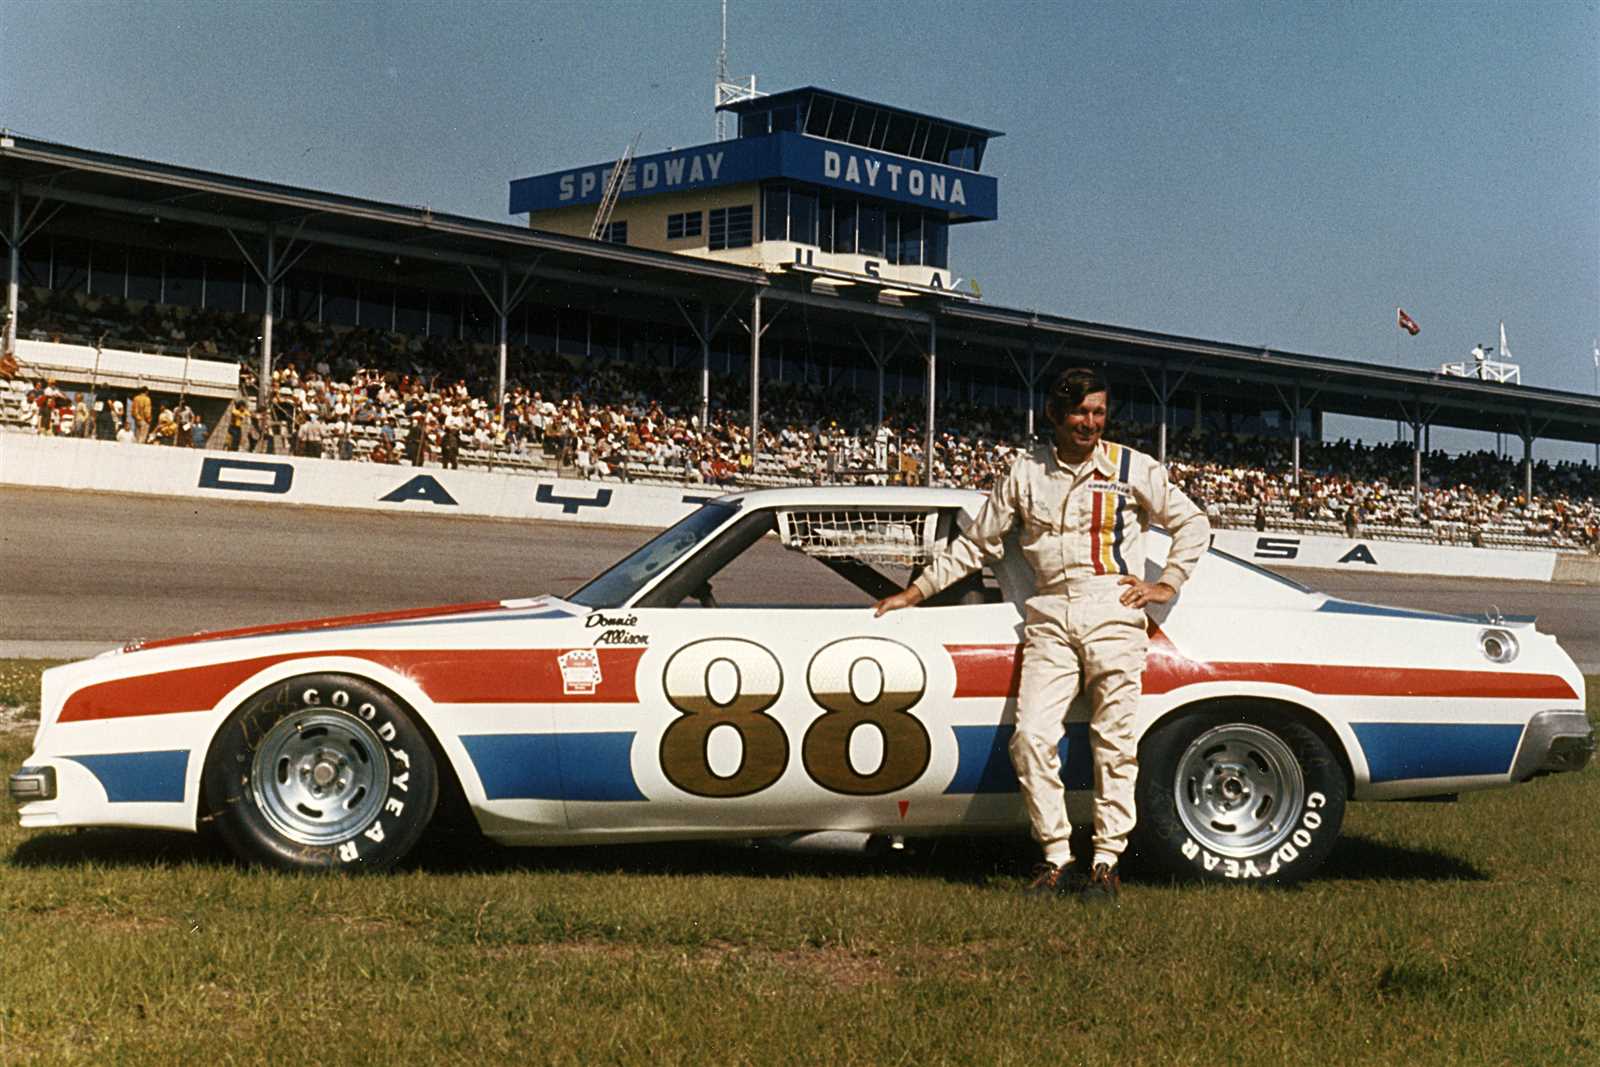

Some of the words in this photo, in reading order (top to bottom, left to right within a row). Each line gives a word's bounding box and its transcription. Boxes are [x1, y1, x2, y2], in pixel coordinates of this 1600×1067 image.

[824, 150, 966, 205] DAYTONA
[585, 613, 638, 628] Donnie
[593, 629, 649, 646] Allison
[659, 636, 931, 798] 88
[303, 689, 410, 862] GOODYEAR
[1181, 791, 1326, 878] GOODYEAR
